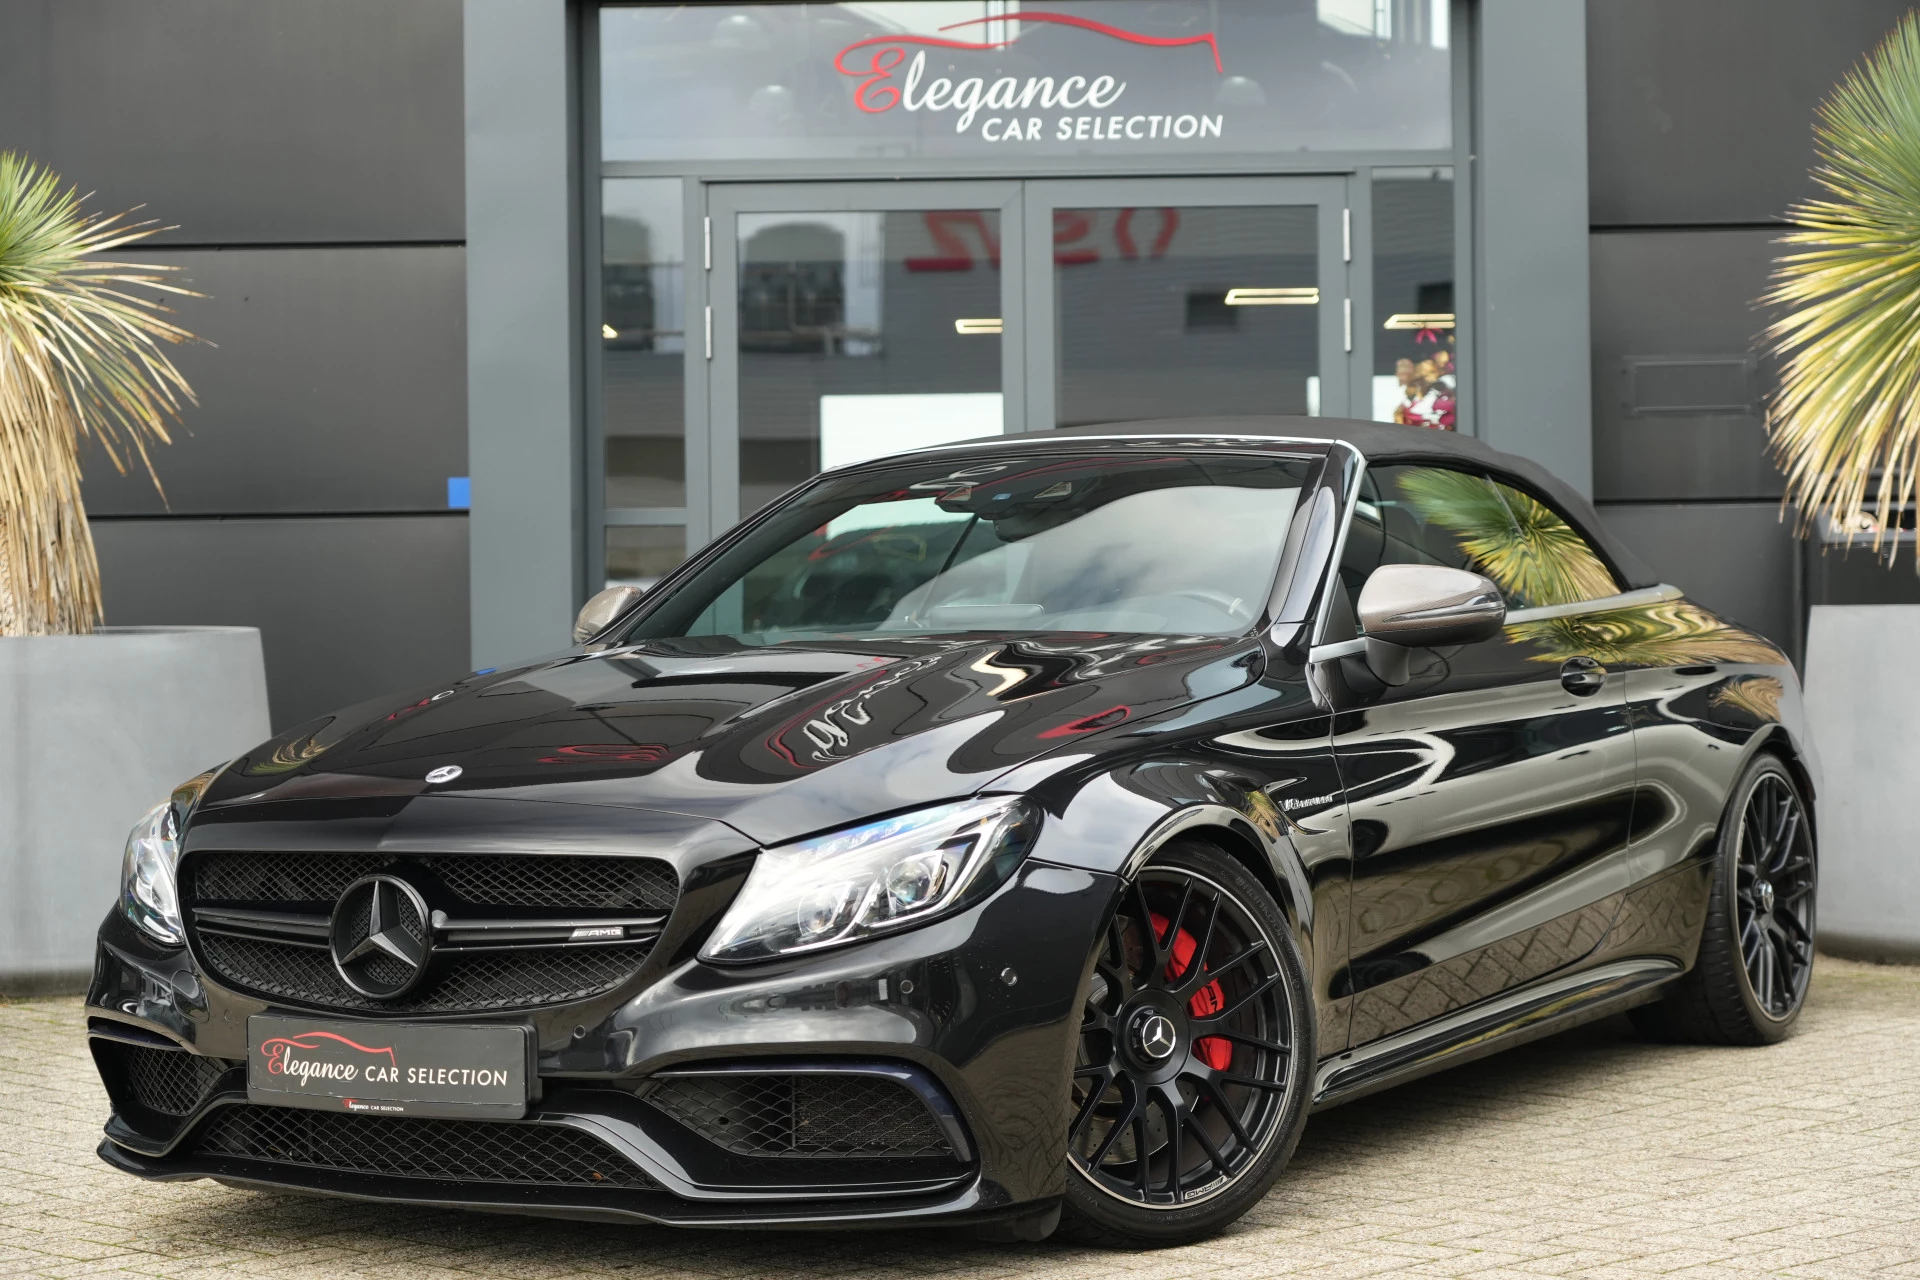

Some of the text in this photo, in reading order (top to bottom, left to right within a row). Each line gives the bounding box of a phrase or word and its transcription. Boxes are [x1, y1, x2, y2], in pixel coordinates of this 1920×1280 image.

[835, 42, 1127, 134] Elegance
[982, 115, 1224, 142] CAR SELECTION
[261, 1042, 508, 1087] Elegance CAR SELECTION
